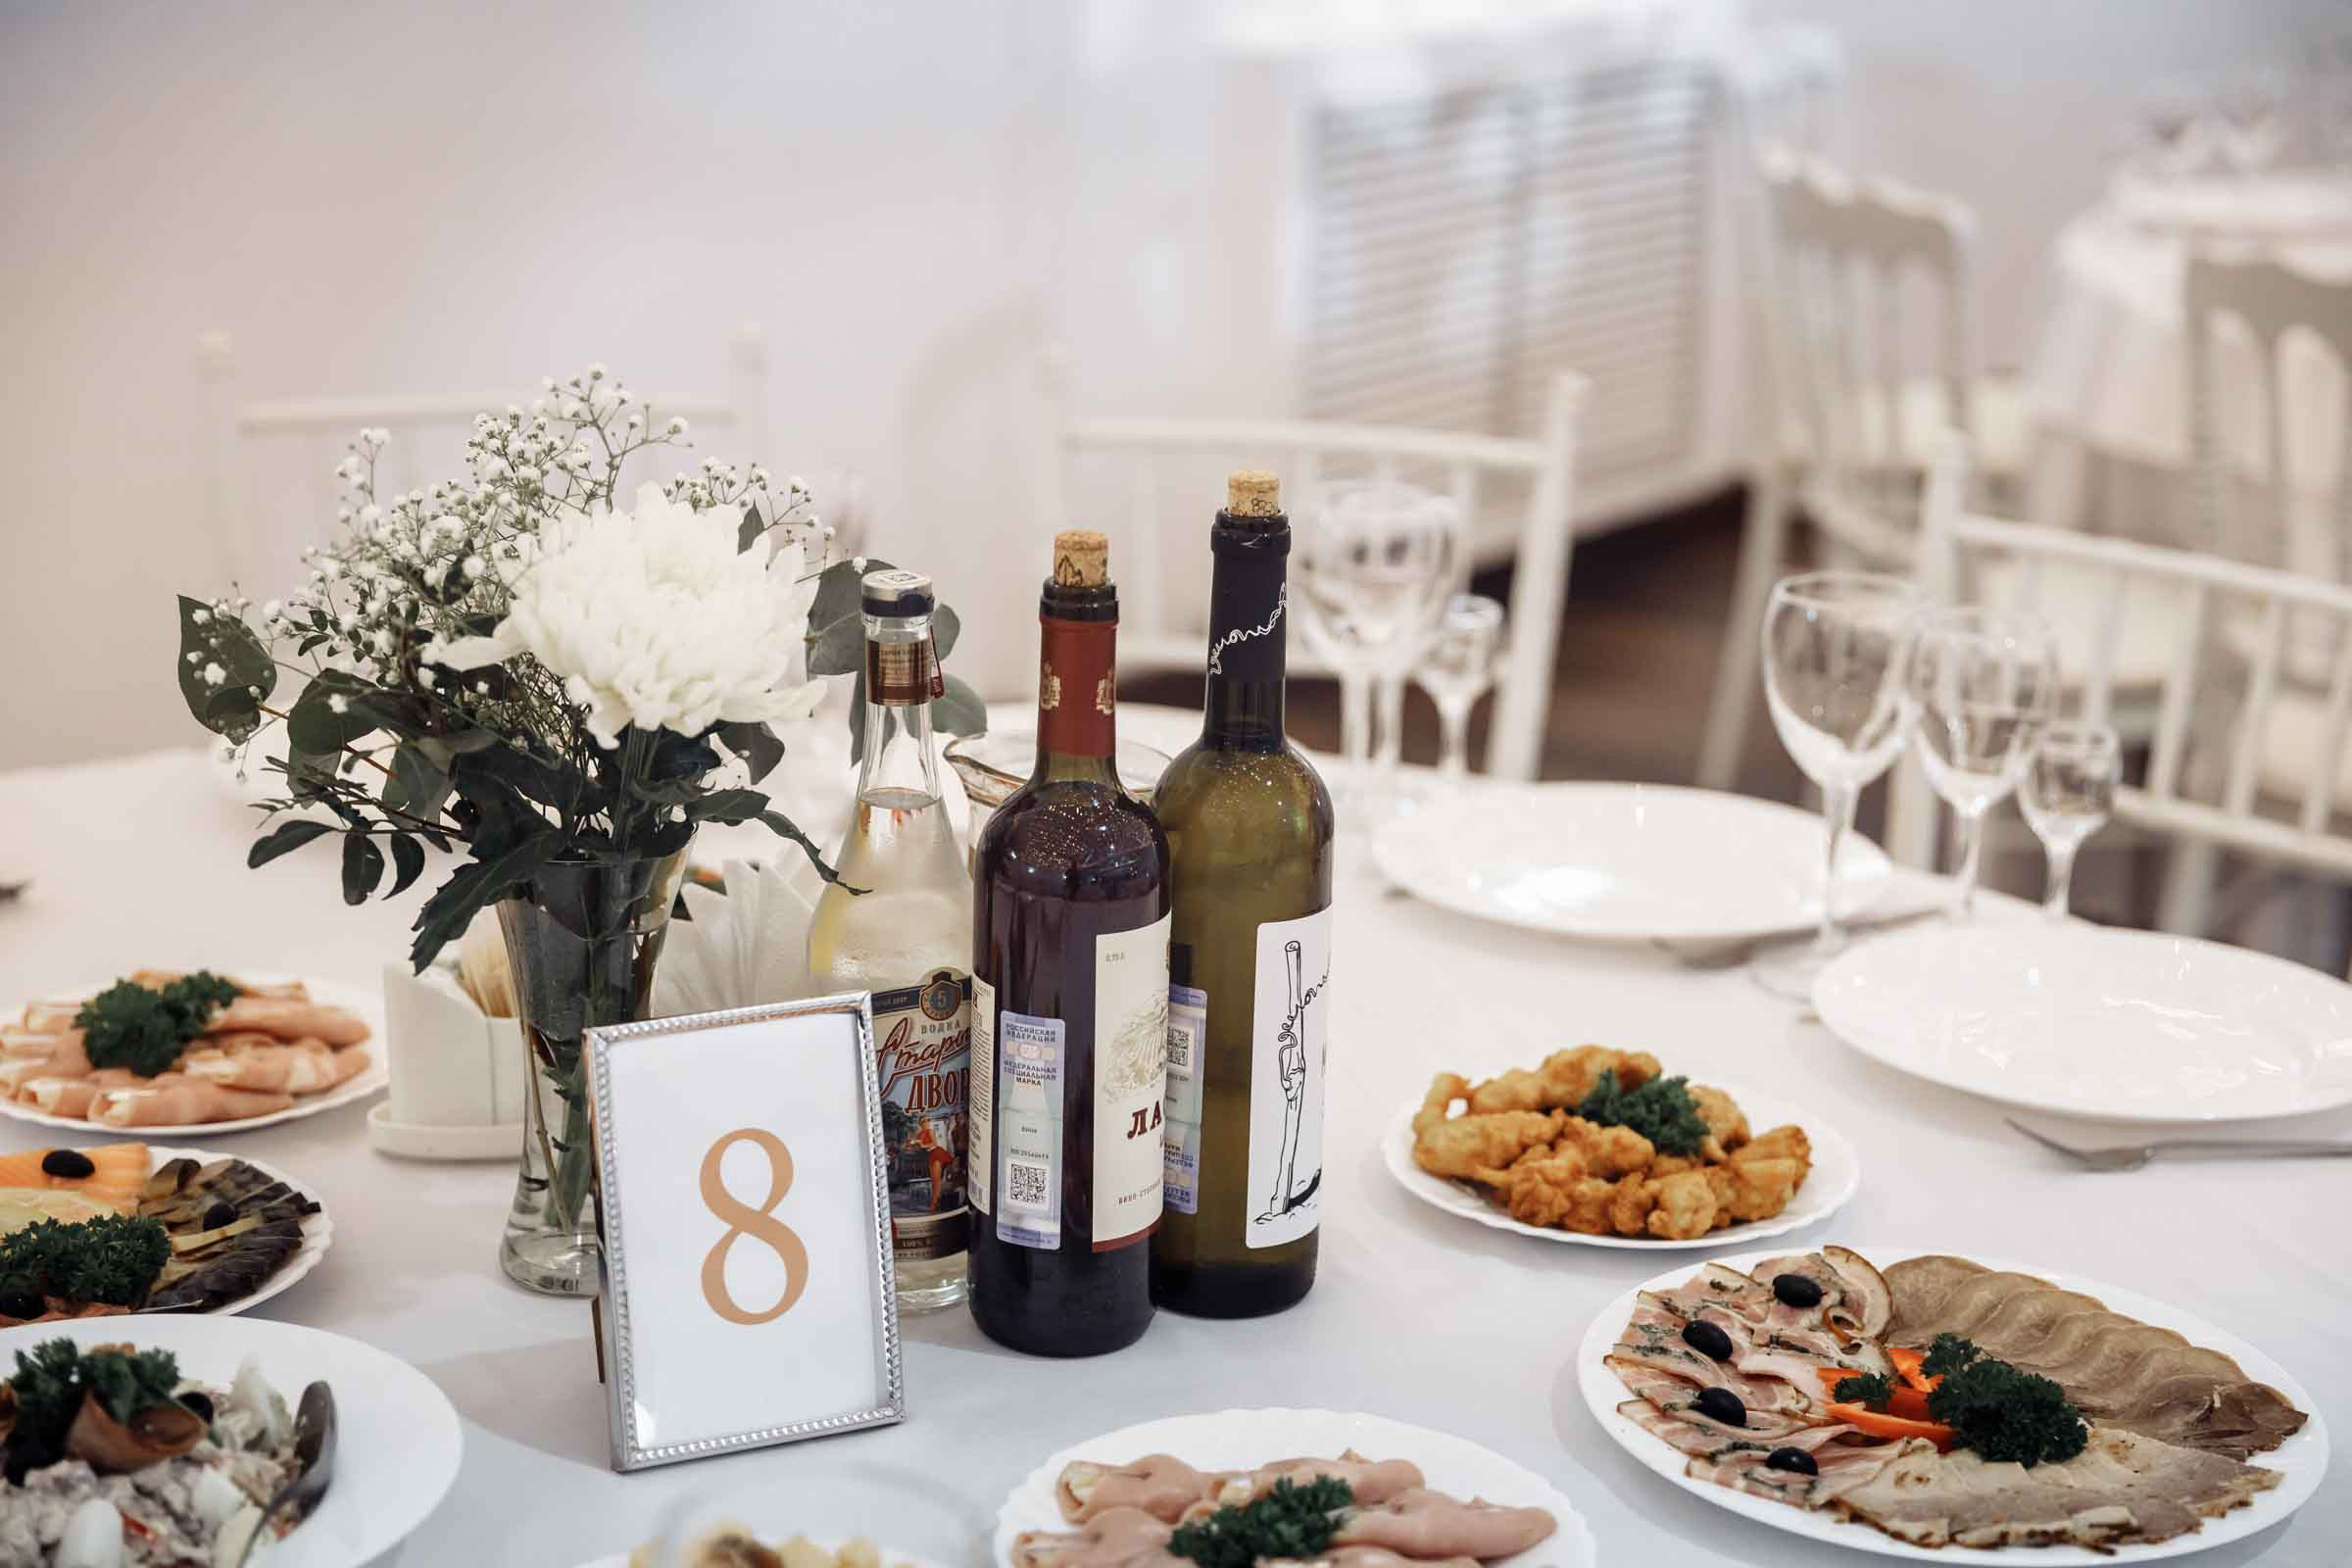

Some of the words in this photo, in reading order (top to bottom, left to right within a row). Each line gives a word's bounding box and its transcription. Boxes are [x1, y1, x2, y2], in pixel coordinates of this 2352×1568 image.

[921, 1019, 961, 1035] ВОДКА
[1015, 1076, 1042, 1087] МАРКА
[699, 1127, 809, 1326] 8
